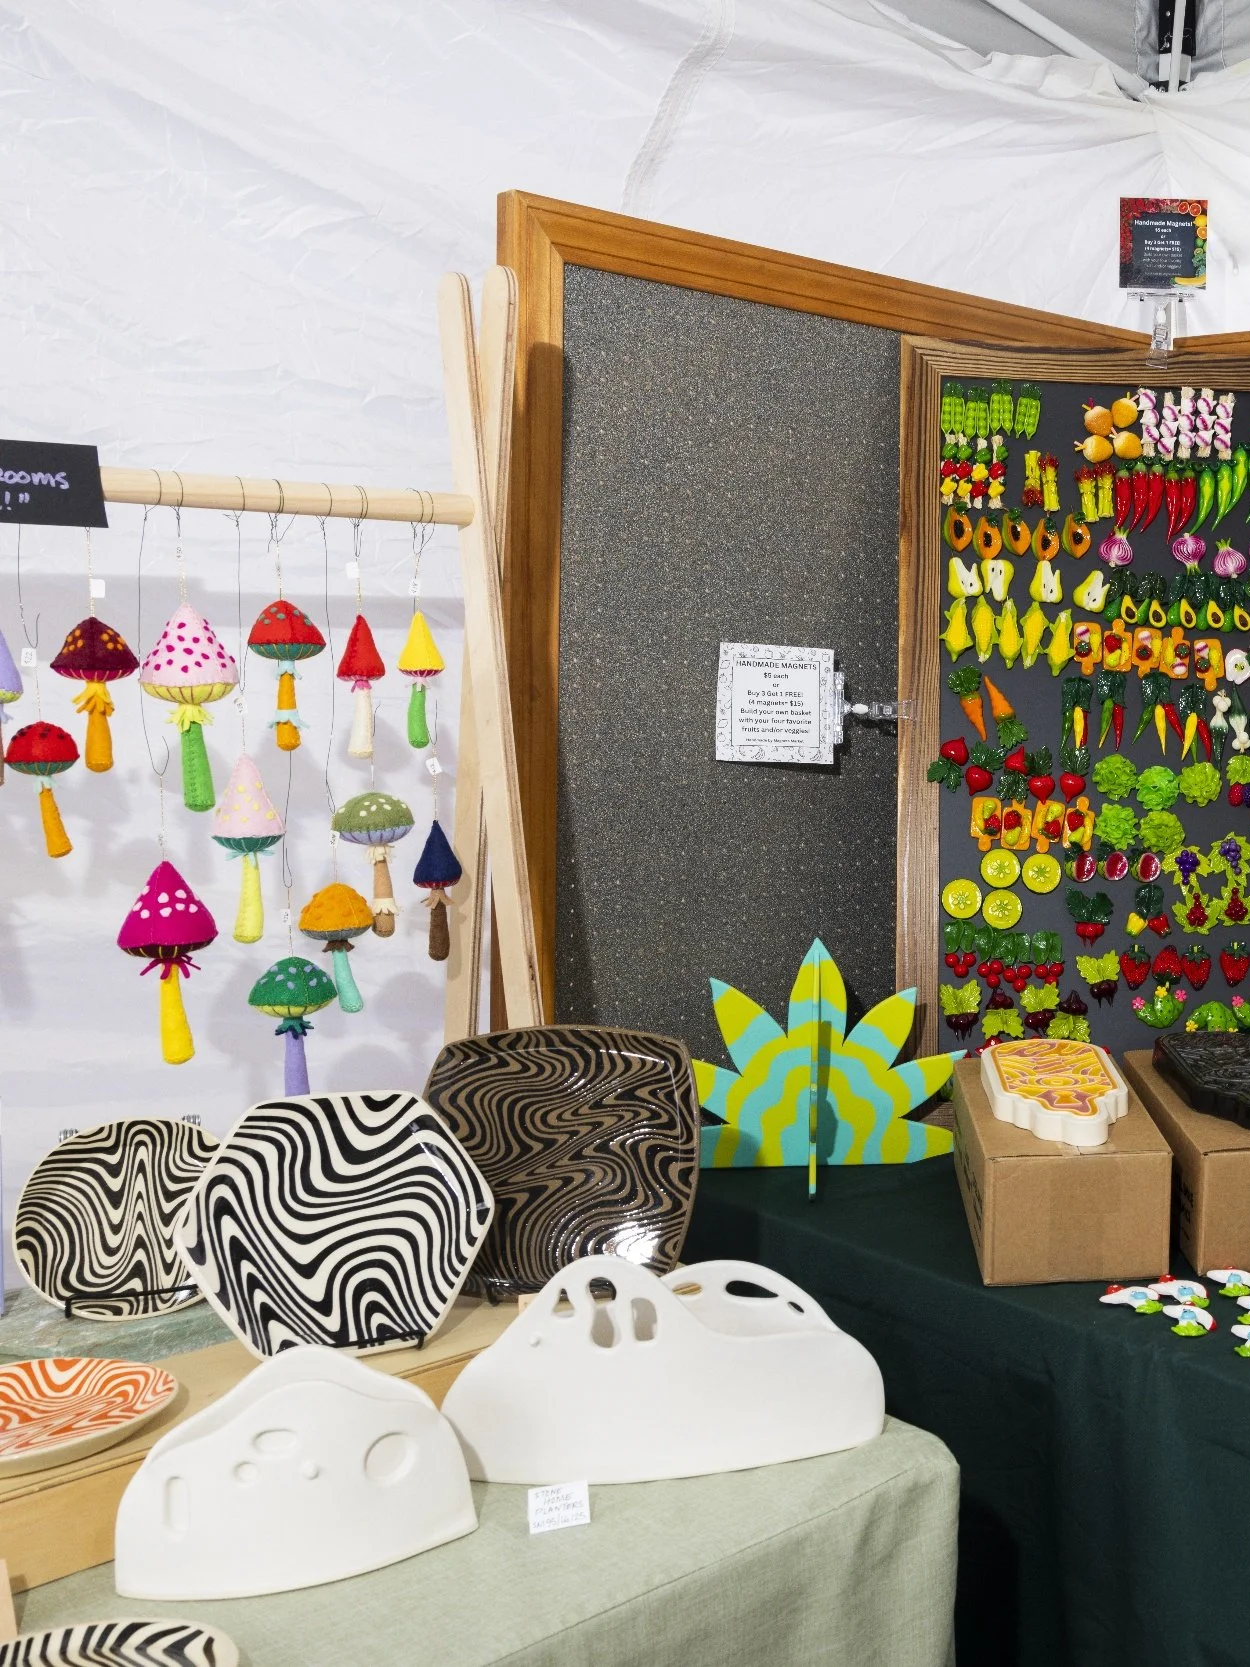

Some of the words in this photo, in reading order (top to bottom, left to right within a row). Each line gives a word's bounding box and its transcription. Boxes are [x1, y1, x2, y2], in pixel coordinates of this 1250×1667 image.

[736, 660, 779, 669] HANDMADE
[781, 662, 817, 670] MAGNETS
[747, 690, 761, 698] Buy
